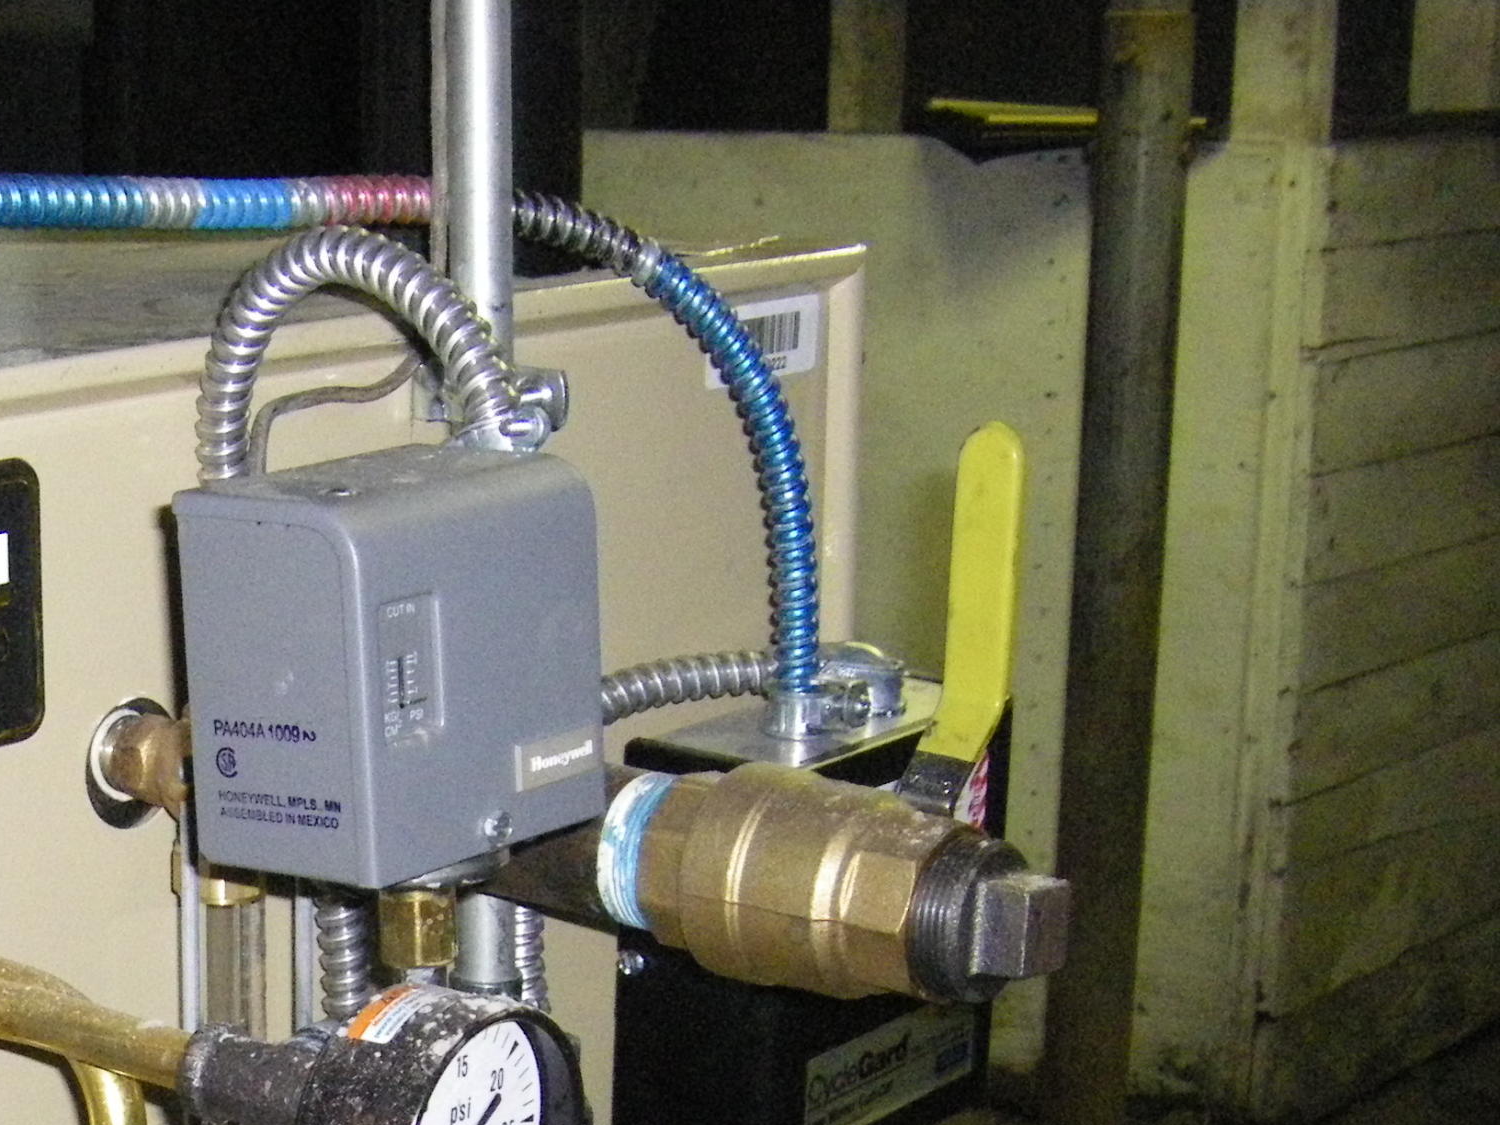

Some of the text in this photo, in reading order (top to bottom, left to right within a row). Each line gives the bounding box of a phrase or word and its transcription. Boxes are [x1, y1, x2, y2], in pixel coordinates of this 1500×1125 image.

[530, 739, 594, 772] Honeywell
[220, 807, 339, 829] ASSEMBLED IN MEXICO
[456, 1055, 469, 1078] 15
[489, 1067, 505, 1092] 20
